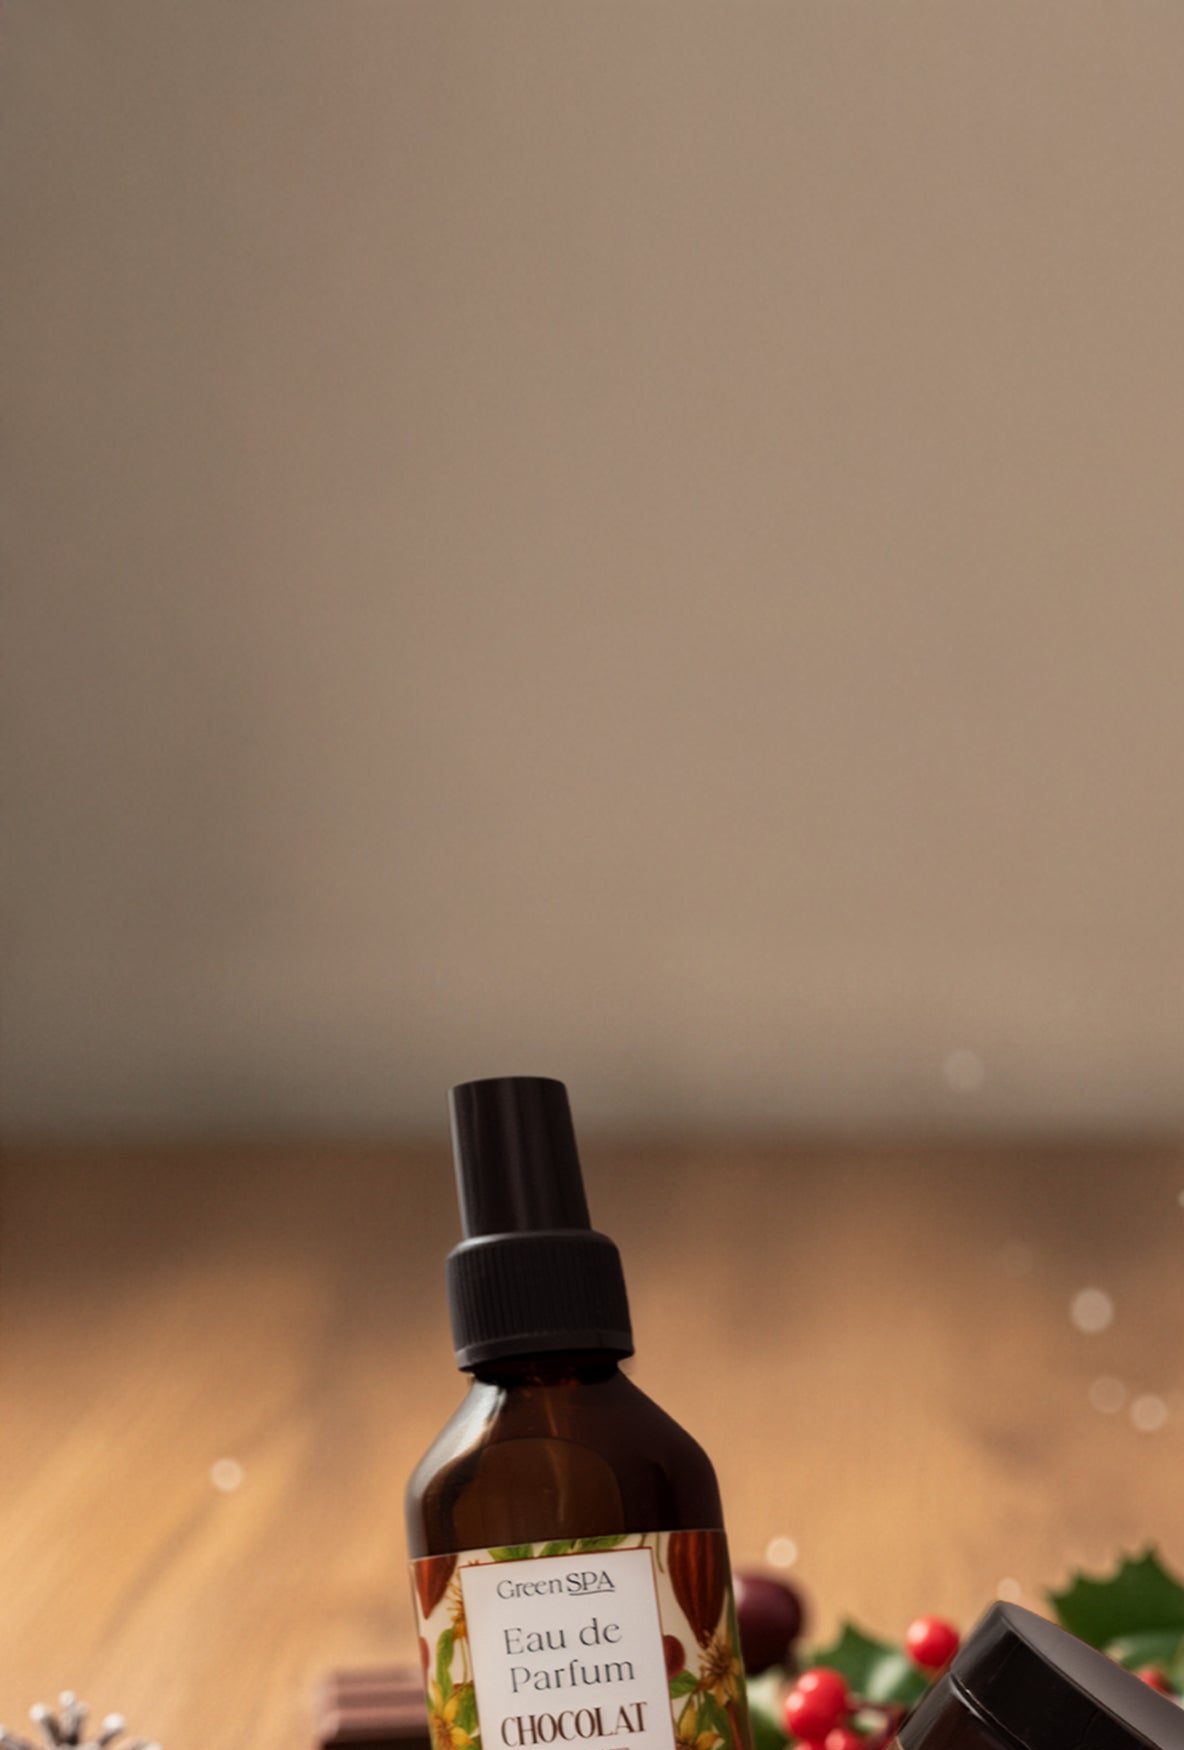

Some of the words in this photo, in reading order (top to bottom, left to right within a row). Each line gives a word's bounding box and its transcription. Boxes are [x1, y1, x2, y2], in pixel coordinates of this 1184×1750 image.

[503, 1627, 567, 1655] Eau
[578, 1617, 621, 1647] de
[509, 1658, 636, 1694] Parfum
[500, 1701, 648, 1747] CHOCOLAT
